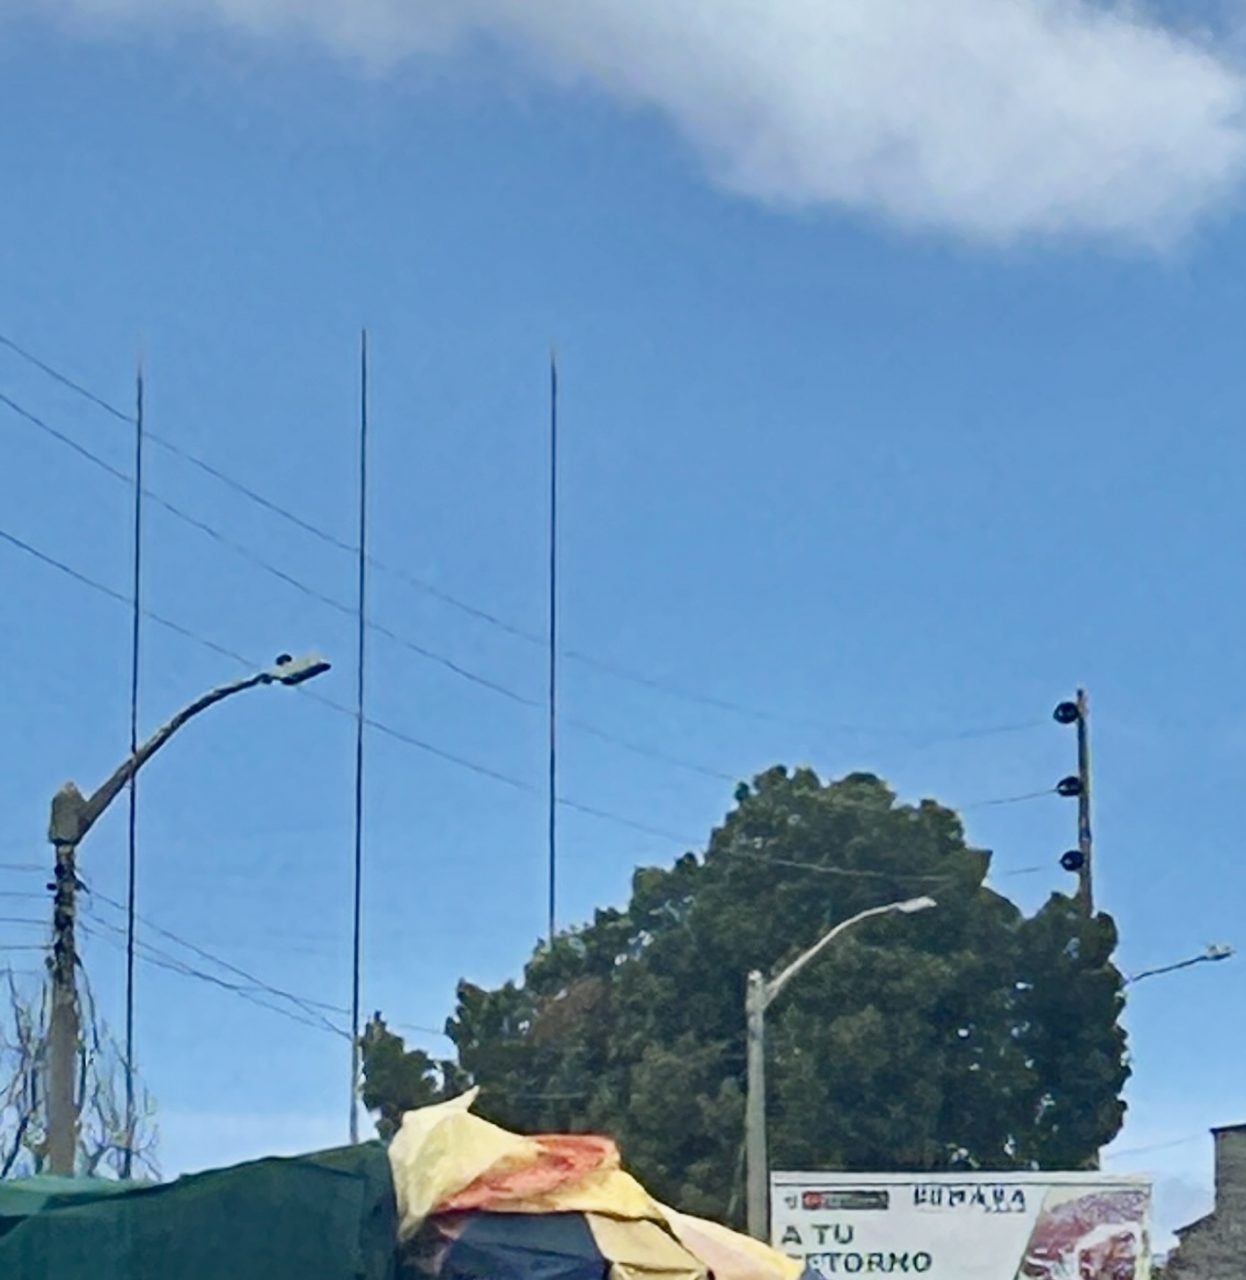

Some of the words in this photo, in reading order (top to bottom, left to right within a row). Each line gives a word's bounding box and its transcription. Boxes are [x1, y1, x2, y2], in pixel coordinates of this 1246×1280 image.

[782, 1225, 803, 1245] A
[812, 1223, 855, 1245] TU
[787, 1251, 933, 1273] TORNO
